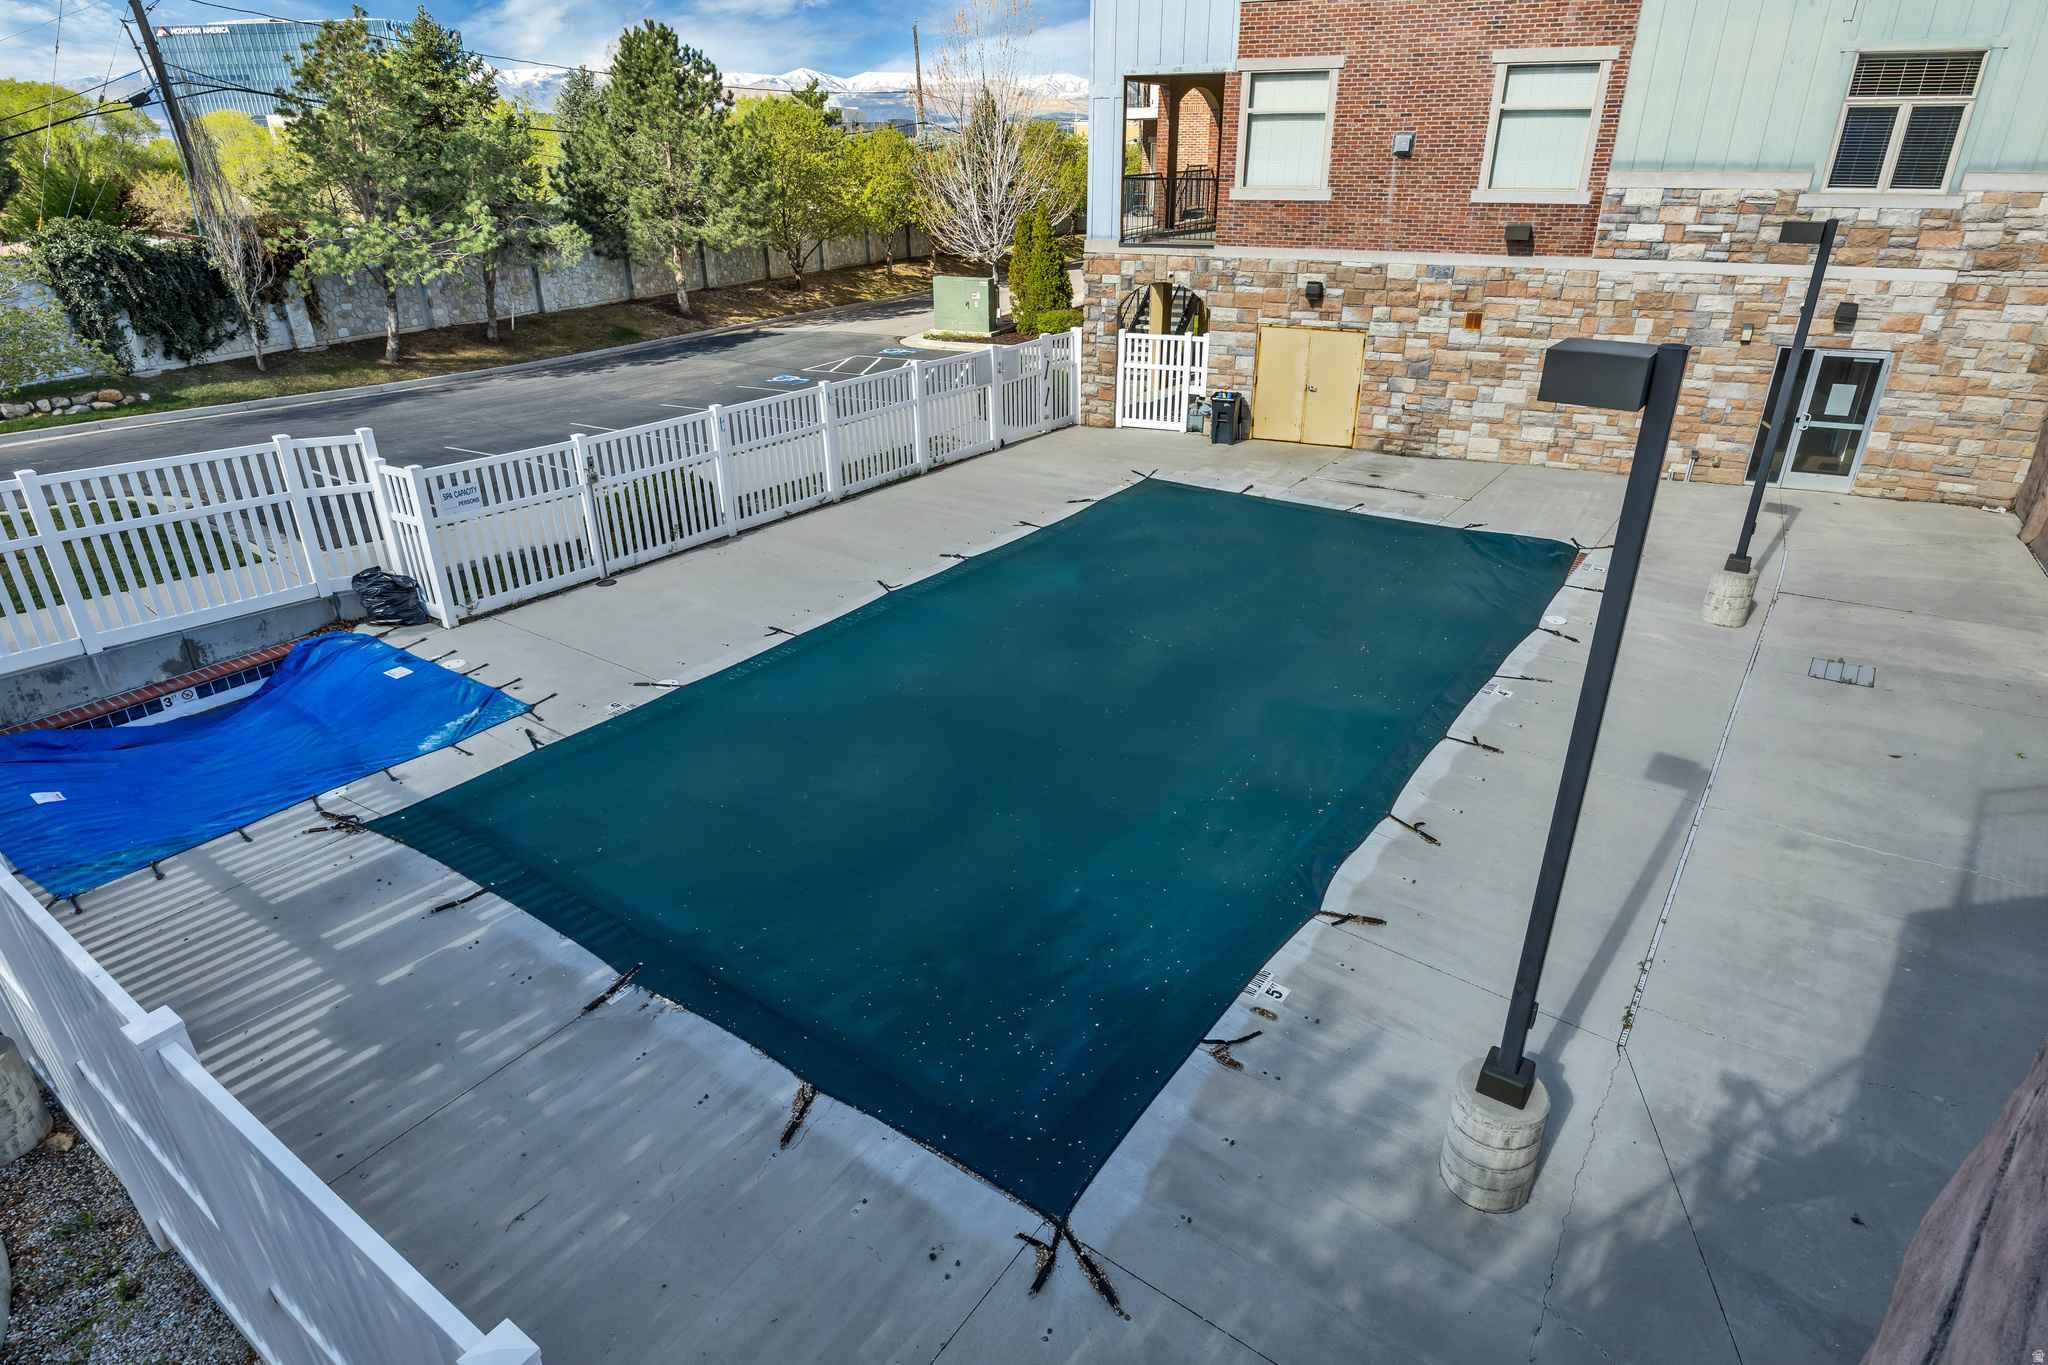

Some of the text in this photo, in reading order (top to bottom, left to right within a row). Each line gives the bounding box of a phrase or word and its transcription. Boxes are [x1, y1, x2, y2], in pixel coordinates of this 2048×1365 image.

[170, 26, 231, 35] MOUNTAIN AMERICA
[442, 486, 478, 501] SPA CAPACITY
[458, 497, 480, 506] PERSONS
[163, 697, 173, 708] 3
[1264, 987, 1283, 999] 5
